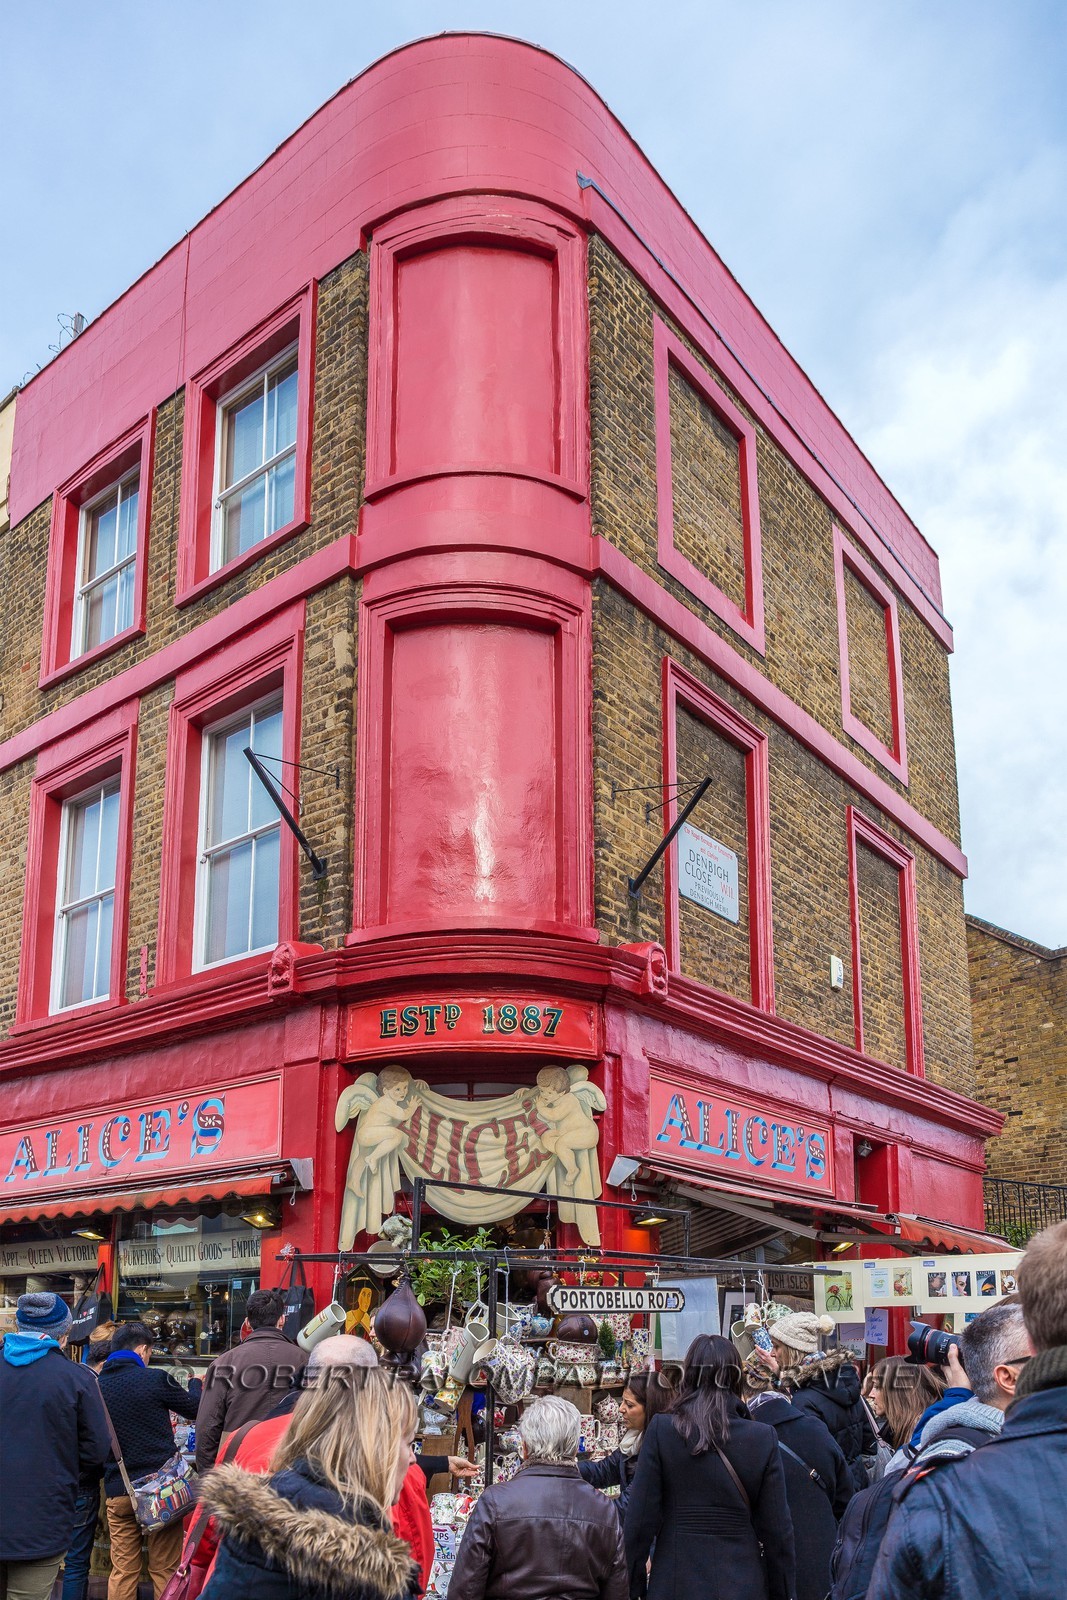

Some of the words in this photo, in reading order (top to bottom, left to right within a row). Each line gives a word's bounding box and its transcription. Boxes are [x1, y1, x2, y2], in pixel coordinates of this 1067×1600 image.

[689, 849, 729, 882] DENBIGH
[689, 888, 714, 907] DENBIGH
[714, 901, 729, 915] MEWS
[694, 882, 724, 904] PREVIOUSLY
[482, 1004, 564, 1038] 1887
[4, 1092, 226, 1182] ALICE'S
[656, 1093, 826, 1181] ALICE'S
[27, 1247, 55, 1269] QUEEN
[56, 1244, 97, 1263] VICTORIA
[123, 1247, 160, 1267] PURVEYORS
[166, 1244, 197, 1267] QUALITY
[198, 1242, 223, 1261] GOODS
[231, 1238, 260, 1258] EMPIRE
[787, 1274, 809, 1290] ISLES
[560, 1290, 644, 1309] PORTOBELLO
[648, 1292, 679, 1309] ROAD
[434, 1532, 449, 1540] UPS
[436, 1552, 456, 1560] Each
